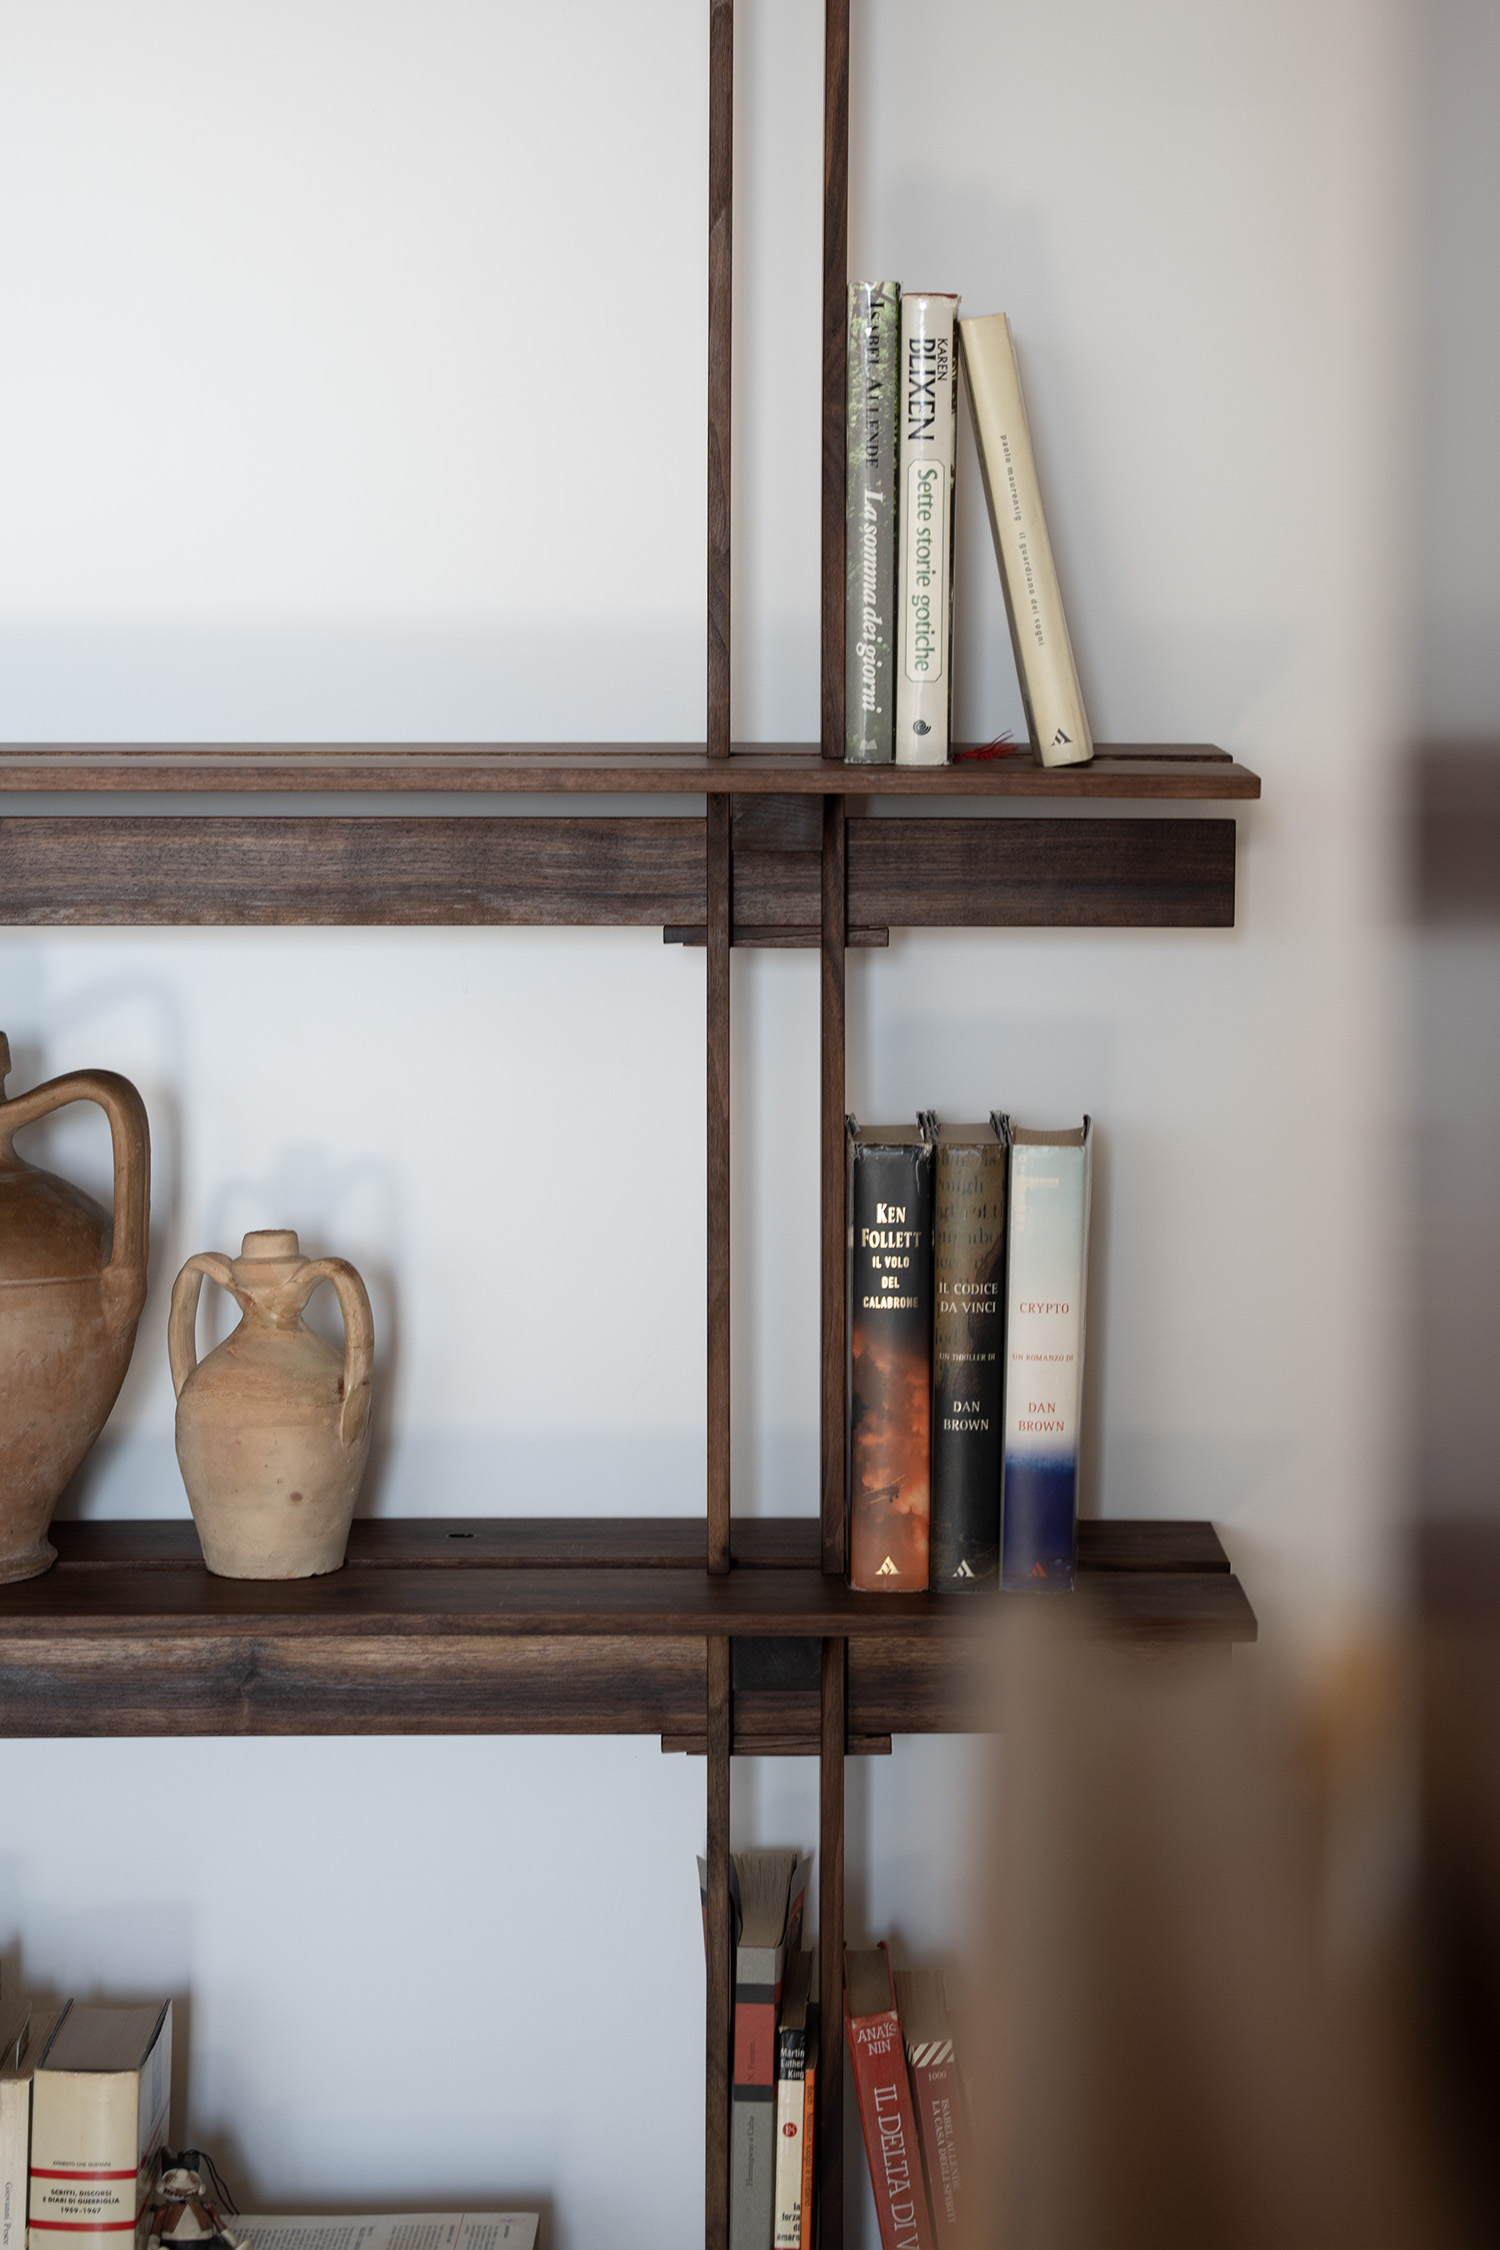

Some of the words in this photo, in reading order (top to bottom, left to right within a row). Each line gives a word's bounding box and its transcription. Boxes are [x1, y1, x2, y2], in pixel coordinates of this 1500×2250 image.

[937, 338, 948, 381] KAREN
[907, 338, 936, 441] BLIXEN
[865, 377, 883, 469] ALLENDE
[1000, 434, 1012, 463] paolo
[916, 468, 938, 521] Sette
[1008, 466, 1022, 521] maurensig
[863, 489, 884, 520] La
[1019, 532, 1026, 541] il
[862, 522, 879, 605] somma
[916, 527, 936, 587] storie
[1019, 543, 1035, 595] guardiano
[1031, 598, 1041, 616] dei
[862, 609, 883, 644] dei
[912, 595, 936, 672] gotiche
[1034, 618, 1045, 646] sogni
[856, 644, 883, 714] giorni
[876, 1203, 907, 1224] KEN
[861, 1228, 922, 1249] FOLLETT
[872, 1256, 882, 1269] IL
[884, 1256, 910, 1269] VOLO
[881, 1276, 900, 1289] DEL
[939, 1282, 950, 1294] IL
[953, 1282, 999, 1295] CODICE
[863, 1296, 919, 1309] CALABRONE
[940, 1301, 957, 1313] DA
[962, 1301, 996, 1314] VINCI
[1019, 1303, 1070, 1315] CRYPTO
[939, 1353, 951, 1361] UN
[952, 1353, 987, 1362] THRILLER
[988, 1353, 996, 1362] DI
[1012, 1353, 1024, 1361] UN
[1026, 1354, 1064, 1362] ROMANZO
[1065, 1354, 1074, 1362] DI
[953, 1401, 980, 1413] DAN
[1028, 1402, 1056, 1413] DAN
[943, 1419, 989, 1431] BROWN
[1018, 1420, 1065, 1432] BROWN
[857, 2022, 897, 2044] ANAÏS
[780, 2047, 805, 2058] Martin
[868, 2041, 891, 2056] NIN
[781, 2058, 805, 2068] Luther
[788, 2069, 805, 2080] King
[928, 2070, 947, 2082] 1000
[874, 2084, 898, 2112] IL
[931, 2099, 942, 2116] LA
[940, 2098, 954, 2138] ISABEL
[933, 2117, 947, 2146] CASA
[878, 2112, 911, 2199] DELTA
[937, 2148, 952, 2182] DEGLI
[782, 2212, 801, 2221] forza
[891, 2200, 917, 2232] DI
